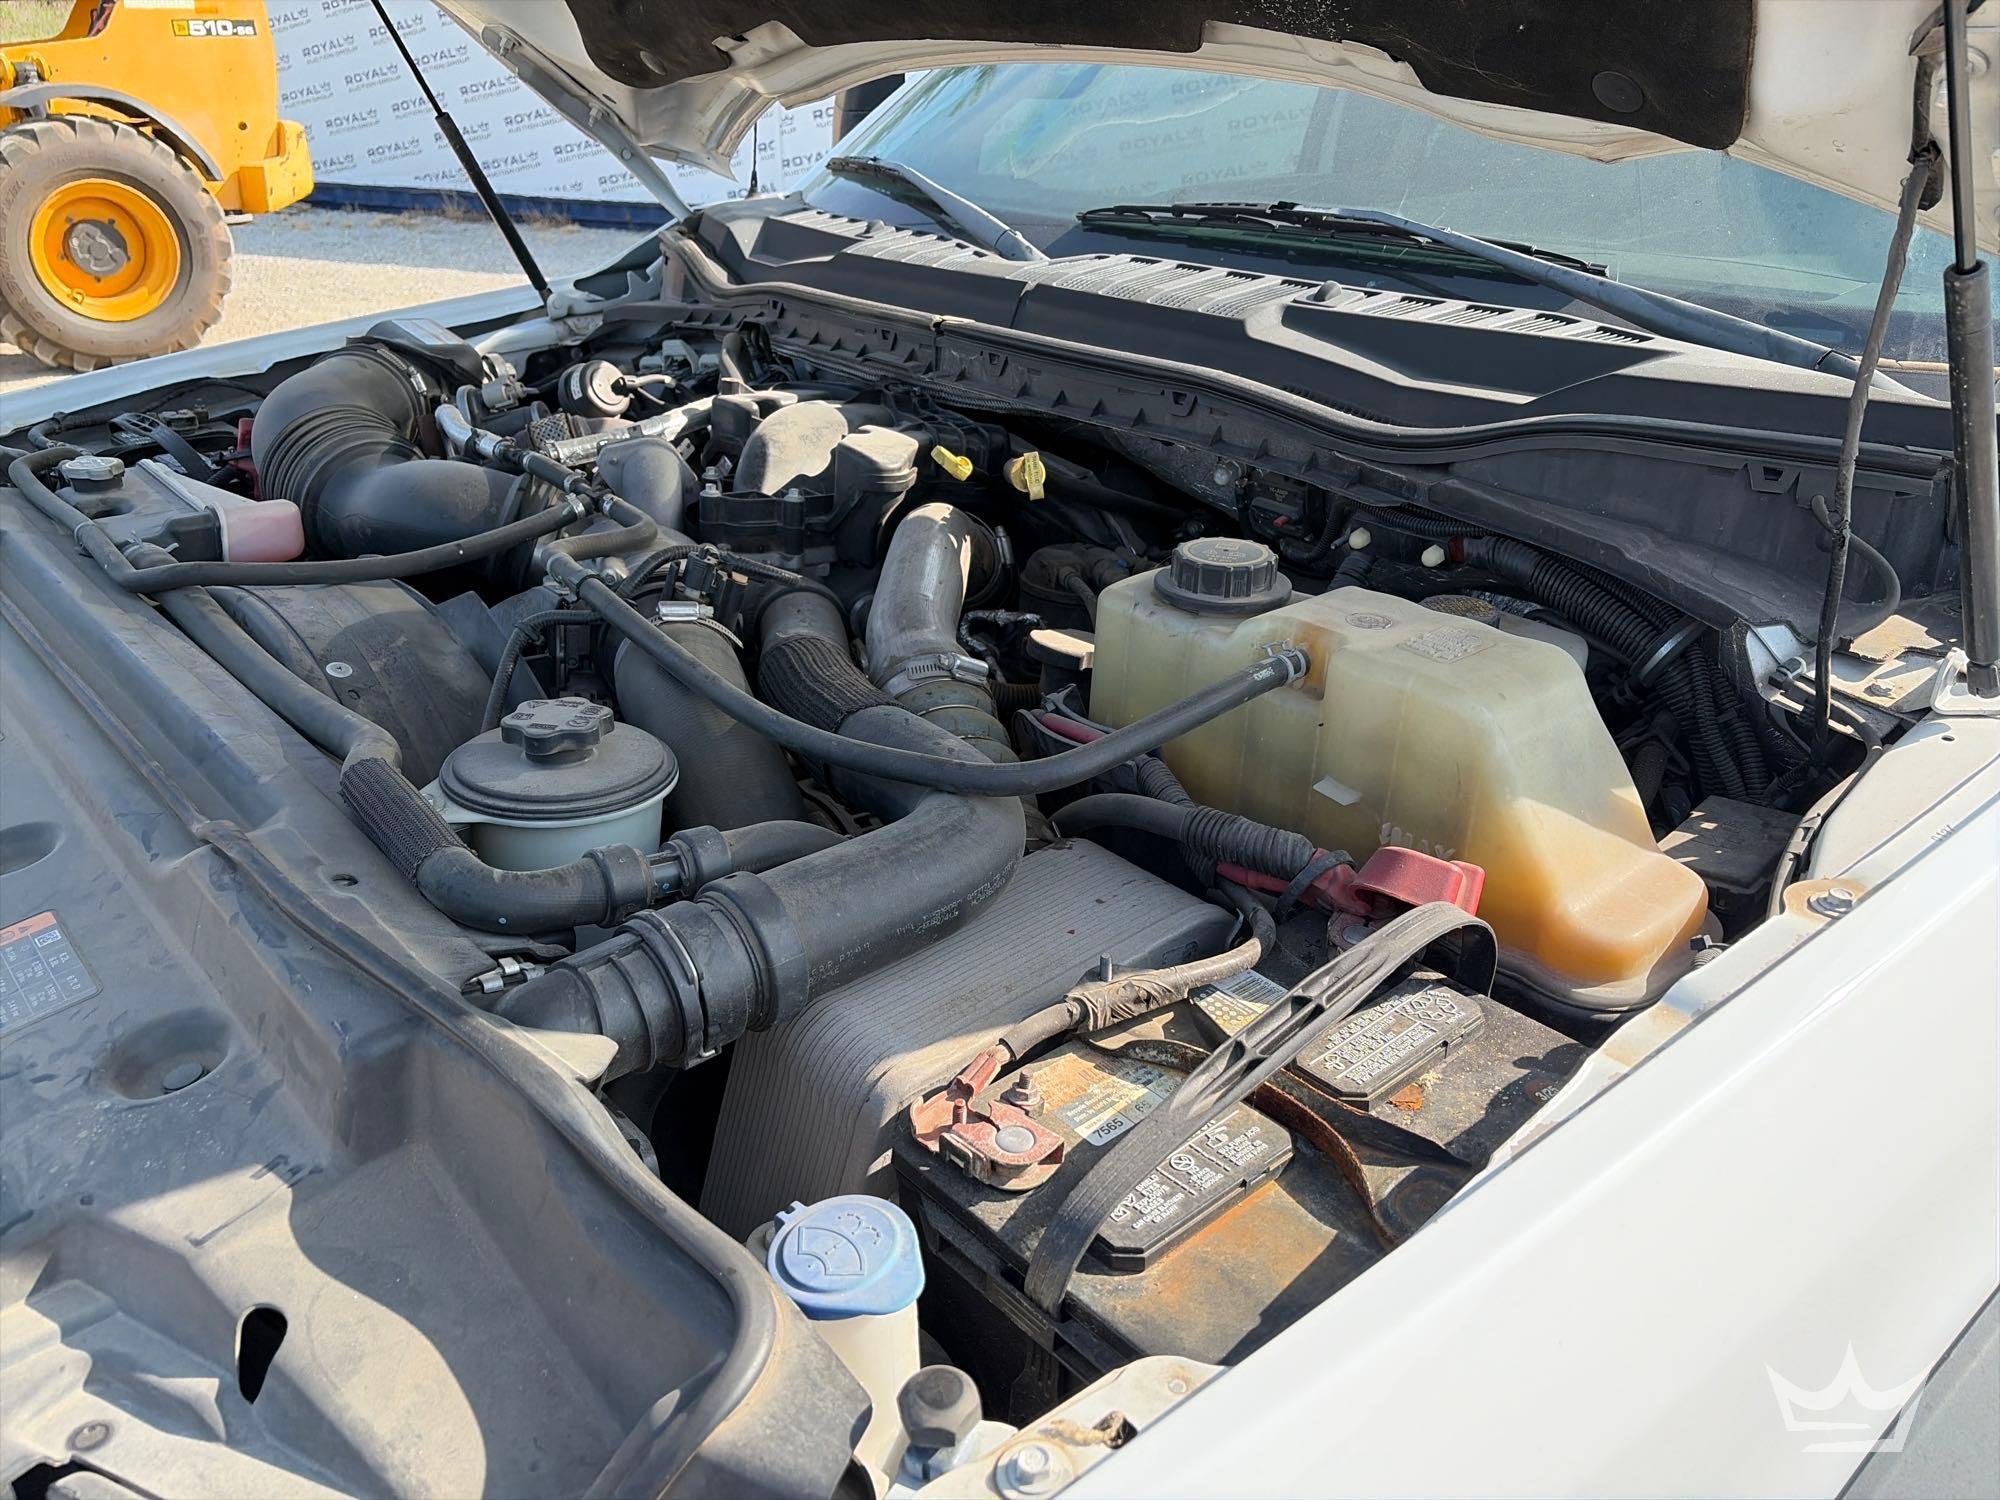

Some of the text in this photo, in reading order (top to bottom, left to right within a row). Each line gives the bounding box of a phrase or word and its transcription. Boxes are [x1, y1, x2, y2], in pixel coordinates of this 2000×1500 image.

[269, 11, 299, 28] OYAL
[369, 20, 414, 38] ROAL
[302, 37, 344, 57] ROYAL
[344, 67, 387, 85] ROYAL
[281, 84, 320, 103] ROYAL
[459, 78, 505, 96] ROYAL
[391, 97, 427, 113] ROYA
[325, 111, 368, 128] ROYAL
[504, 108, 551, 128] ROYAL
[367, 142, 411, 157] ROYAL
[313, 158, 344, 171] OYAL
[481, 154, 527, 170] ROYAL
[781, 151, 827, 169] ROYA
[1092, 1117, 1124, 1138] 7565
